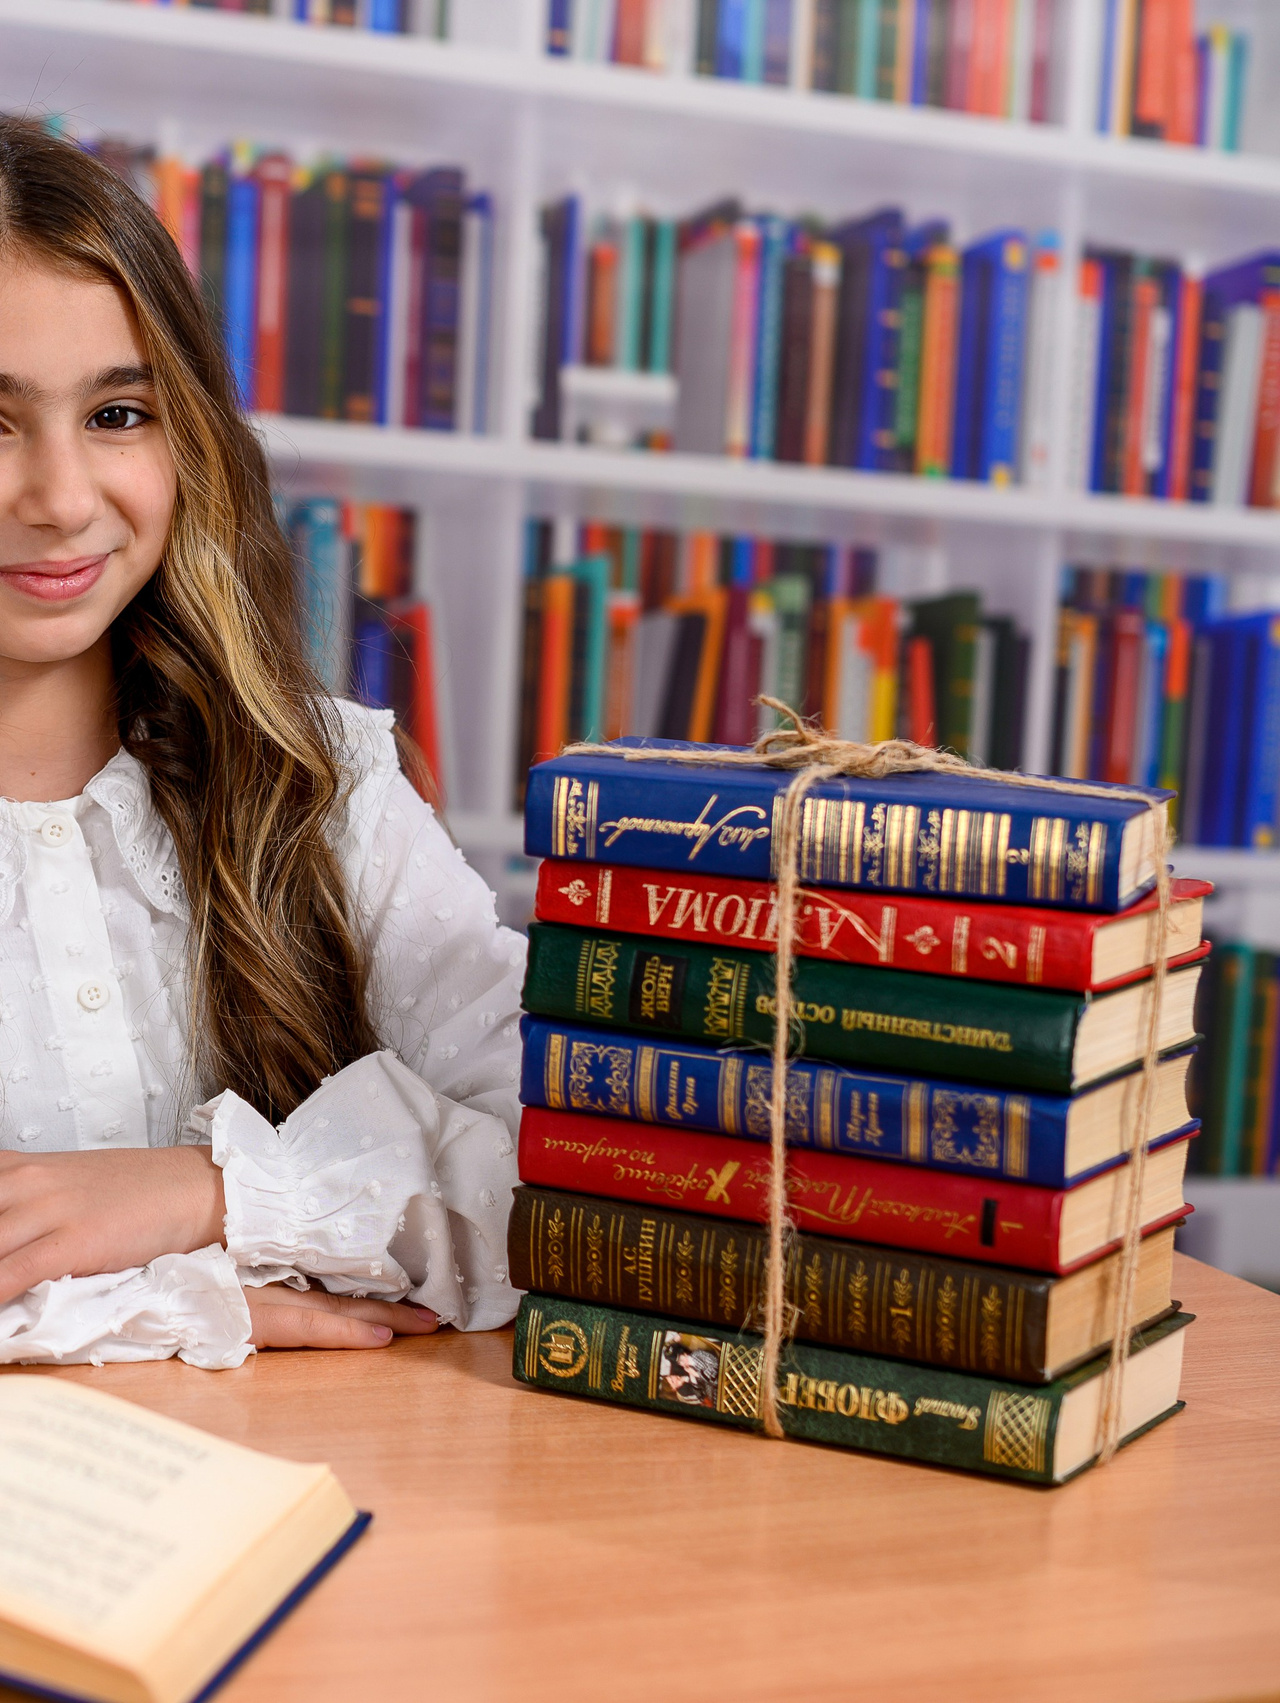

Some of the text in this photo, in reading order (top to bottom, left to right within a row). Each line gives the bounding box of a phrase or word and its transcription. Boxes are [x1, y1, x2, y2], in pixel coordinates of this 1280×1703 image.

[1006, 848, 1029, 865] 2
[983, 935, 1018, 968] 2
[641, 955, 661, 1019] ЖЮЛЬ
[656, 964, 675, 1013] ВЕРН
[756, 995, 1013, 1051] ТАИНСТВЕННЫЙ ОСТОВ
[612, 1163, 741, 1206] Хождение
[744, 1168, 977, 1239] Алексей Толсой
[889, 1306, 913, 1319] 1
[777, 1373, 910, 1426] ФЛОБЕР
